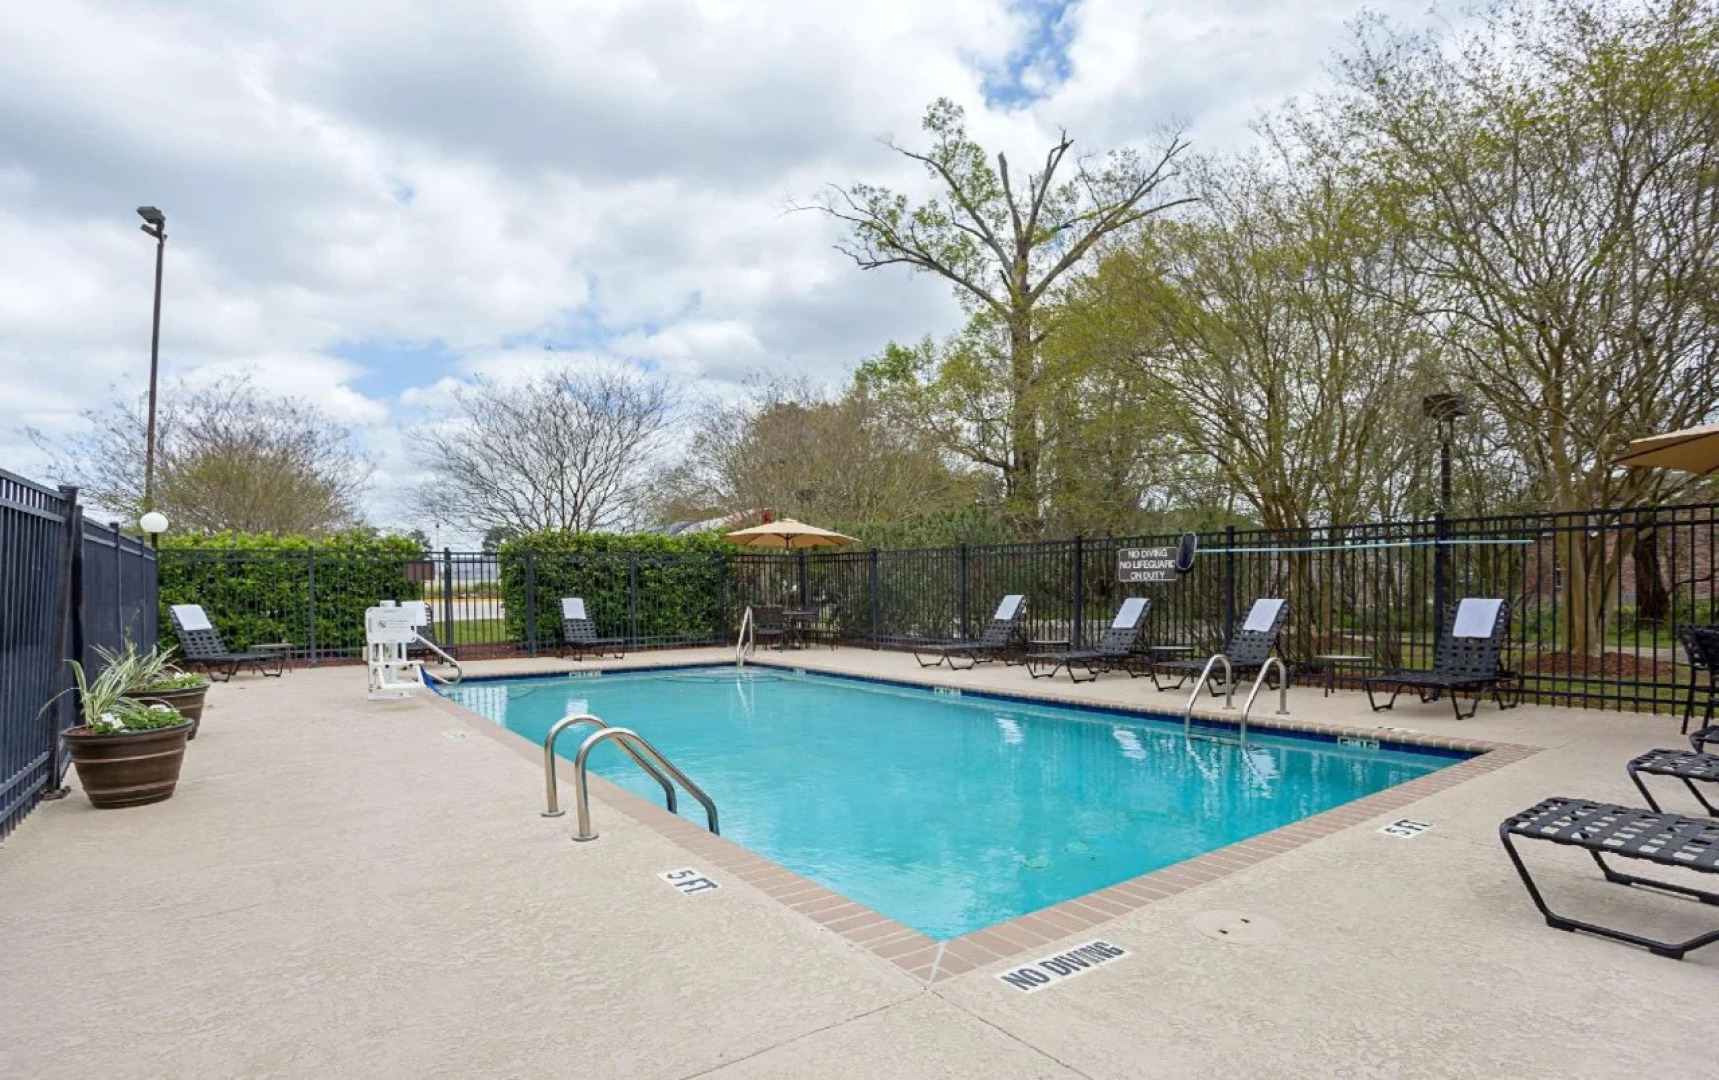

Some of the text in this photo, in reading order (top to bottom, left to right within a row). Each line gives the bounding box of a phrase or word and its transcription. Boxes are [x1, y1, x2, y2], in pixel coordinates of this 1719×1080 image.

[1128, 549, 1168, 559] NO DIVING
[1120, 560, 1175, 569] NO LIFEGUARD
[1130, 571, 1165, 580] ON DUTY
[1384, 819, 1429, 835] 5 FT
[667, 870, 718, 893] 5 FT
[1000, 941, 1125, 991] NO DIVING
